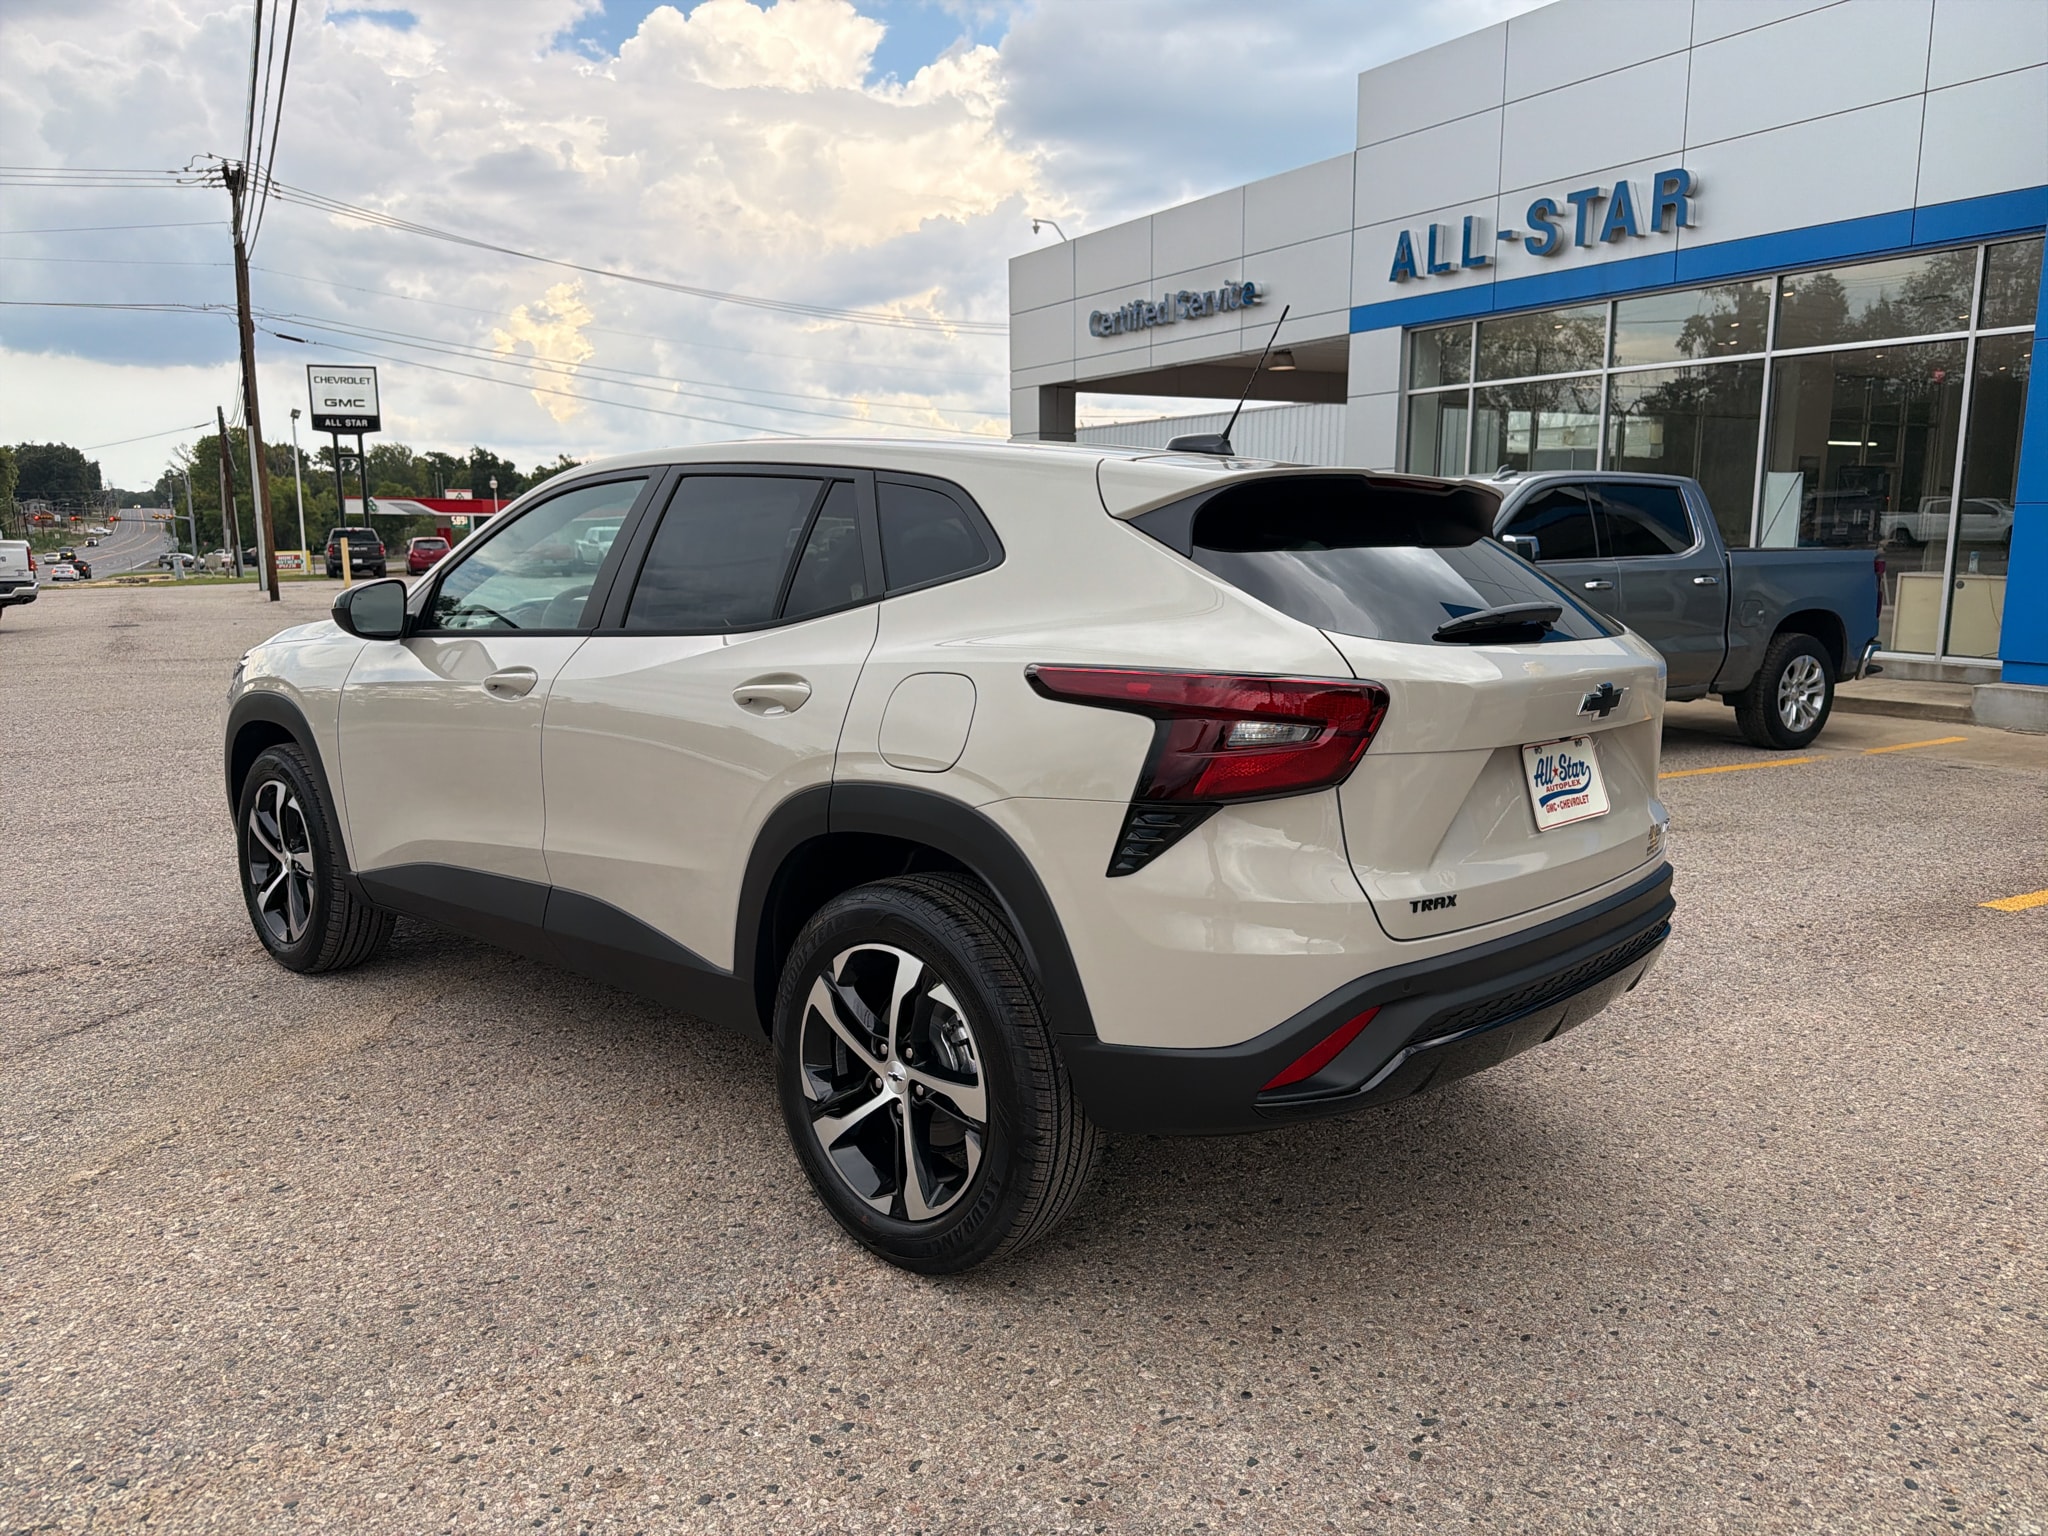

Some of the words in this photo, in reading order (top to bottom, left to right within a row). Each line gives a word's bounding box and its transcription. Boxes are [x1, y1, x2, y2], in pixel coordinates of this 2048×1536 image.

[1388, 167, 1698, 282] ALL-STAR
[1089, 293, 1174, 337] Certified
[1176, 279, 1260, 319] Service
[313, 375, 371, 385] CHEVROLET
[324, 398, 366, 408] GMC
[324, 419, 342, 427] ALL
[345, 419, 368, 428] STAR
[1533, 755, 1555, 788] All
[1558, 753, 1590, 781] Star
[1545, 778, 1581, 793] AUTOPLEX
[1559, 794, 1589, 810] CHEVROLET
[1409, 894, 1457, 913] TRAX
